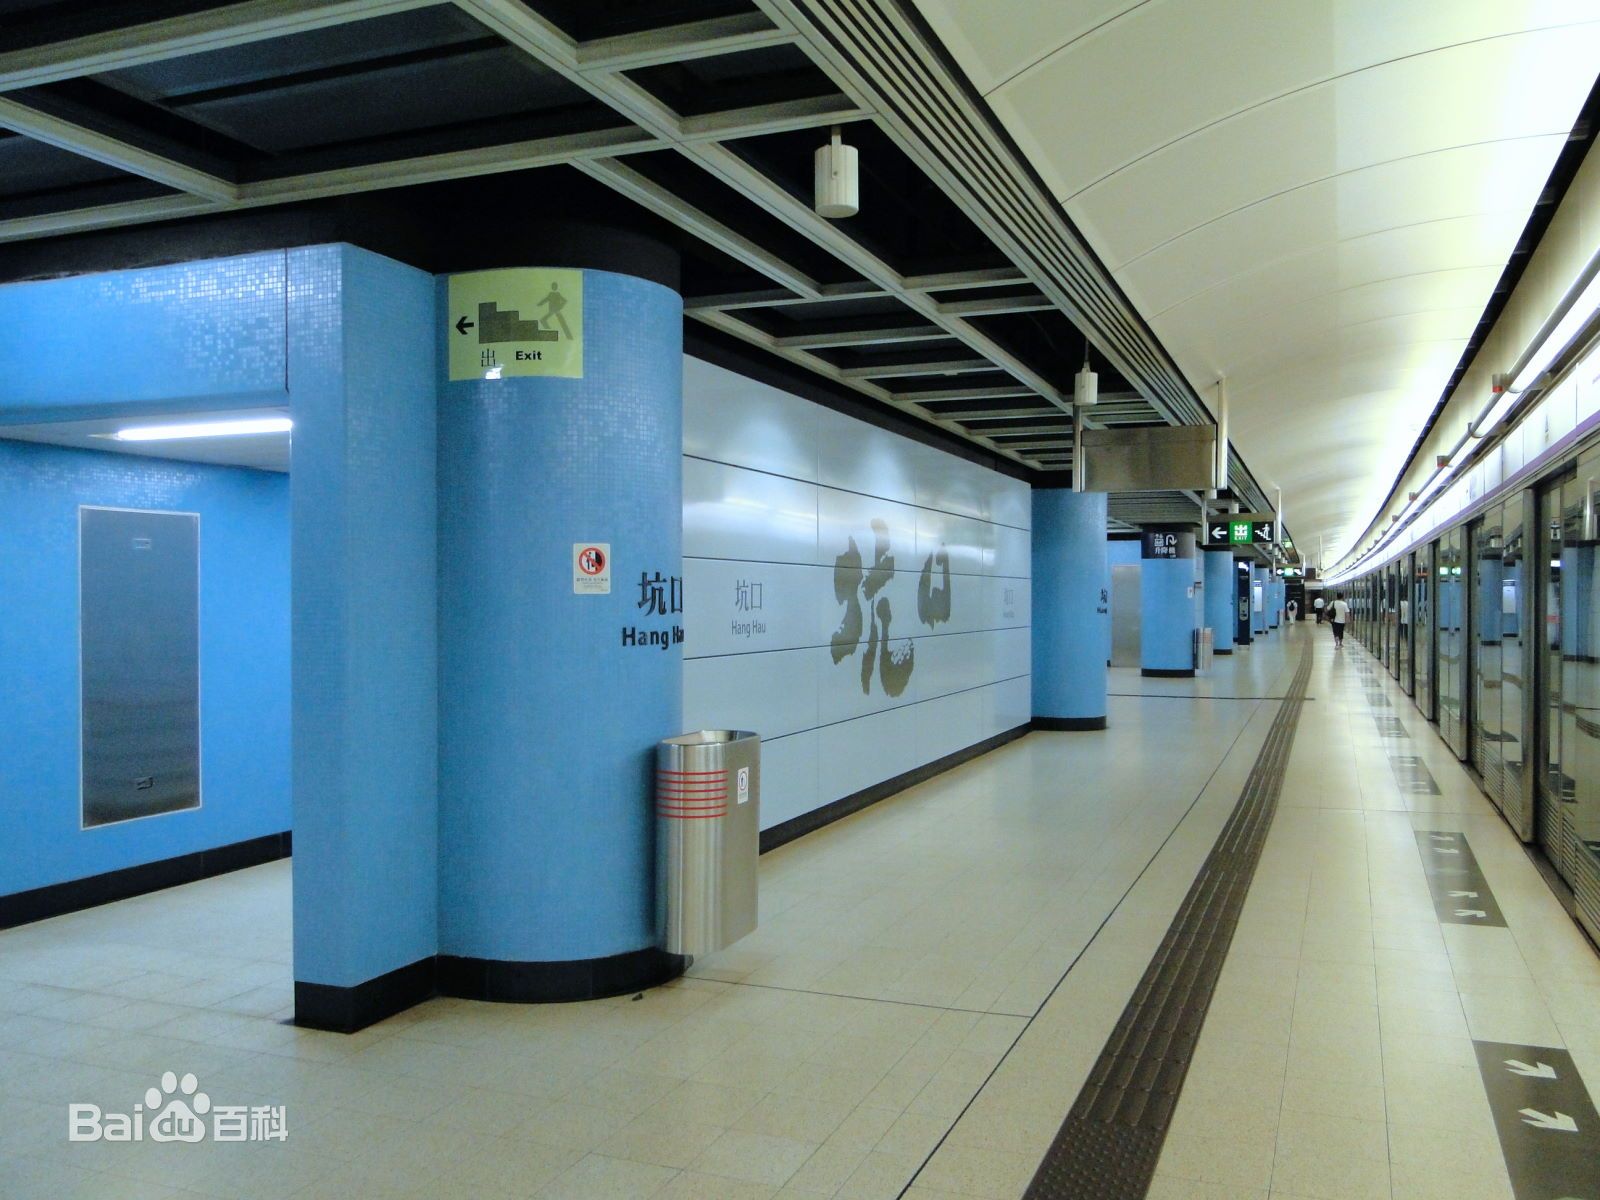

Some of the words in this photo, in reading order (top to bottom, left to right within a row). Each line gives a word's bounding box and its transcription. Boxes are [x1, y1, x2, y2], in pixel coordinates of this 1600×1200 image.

[515, 351, 542, 361] Exit
[637, 571, 683, 616] 坑口
[735, 579, 763, 612] 坑口
[622, 626, 669, 650] Hang
[731, 619, 751, 638] Hang
[752, 619, 766, 635] Hau
